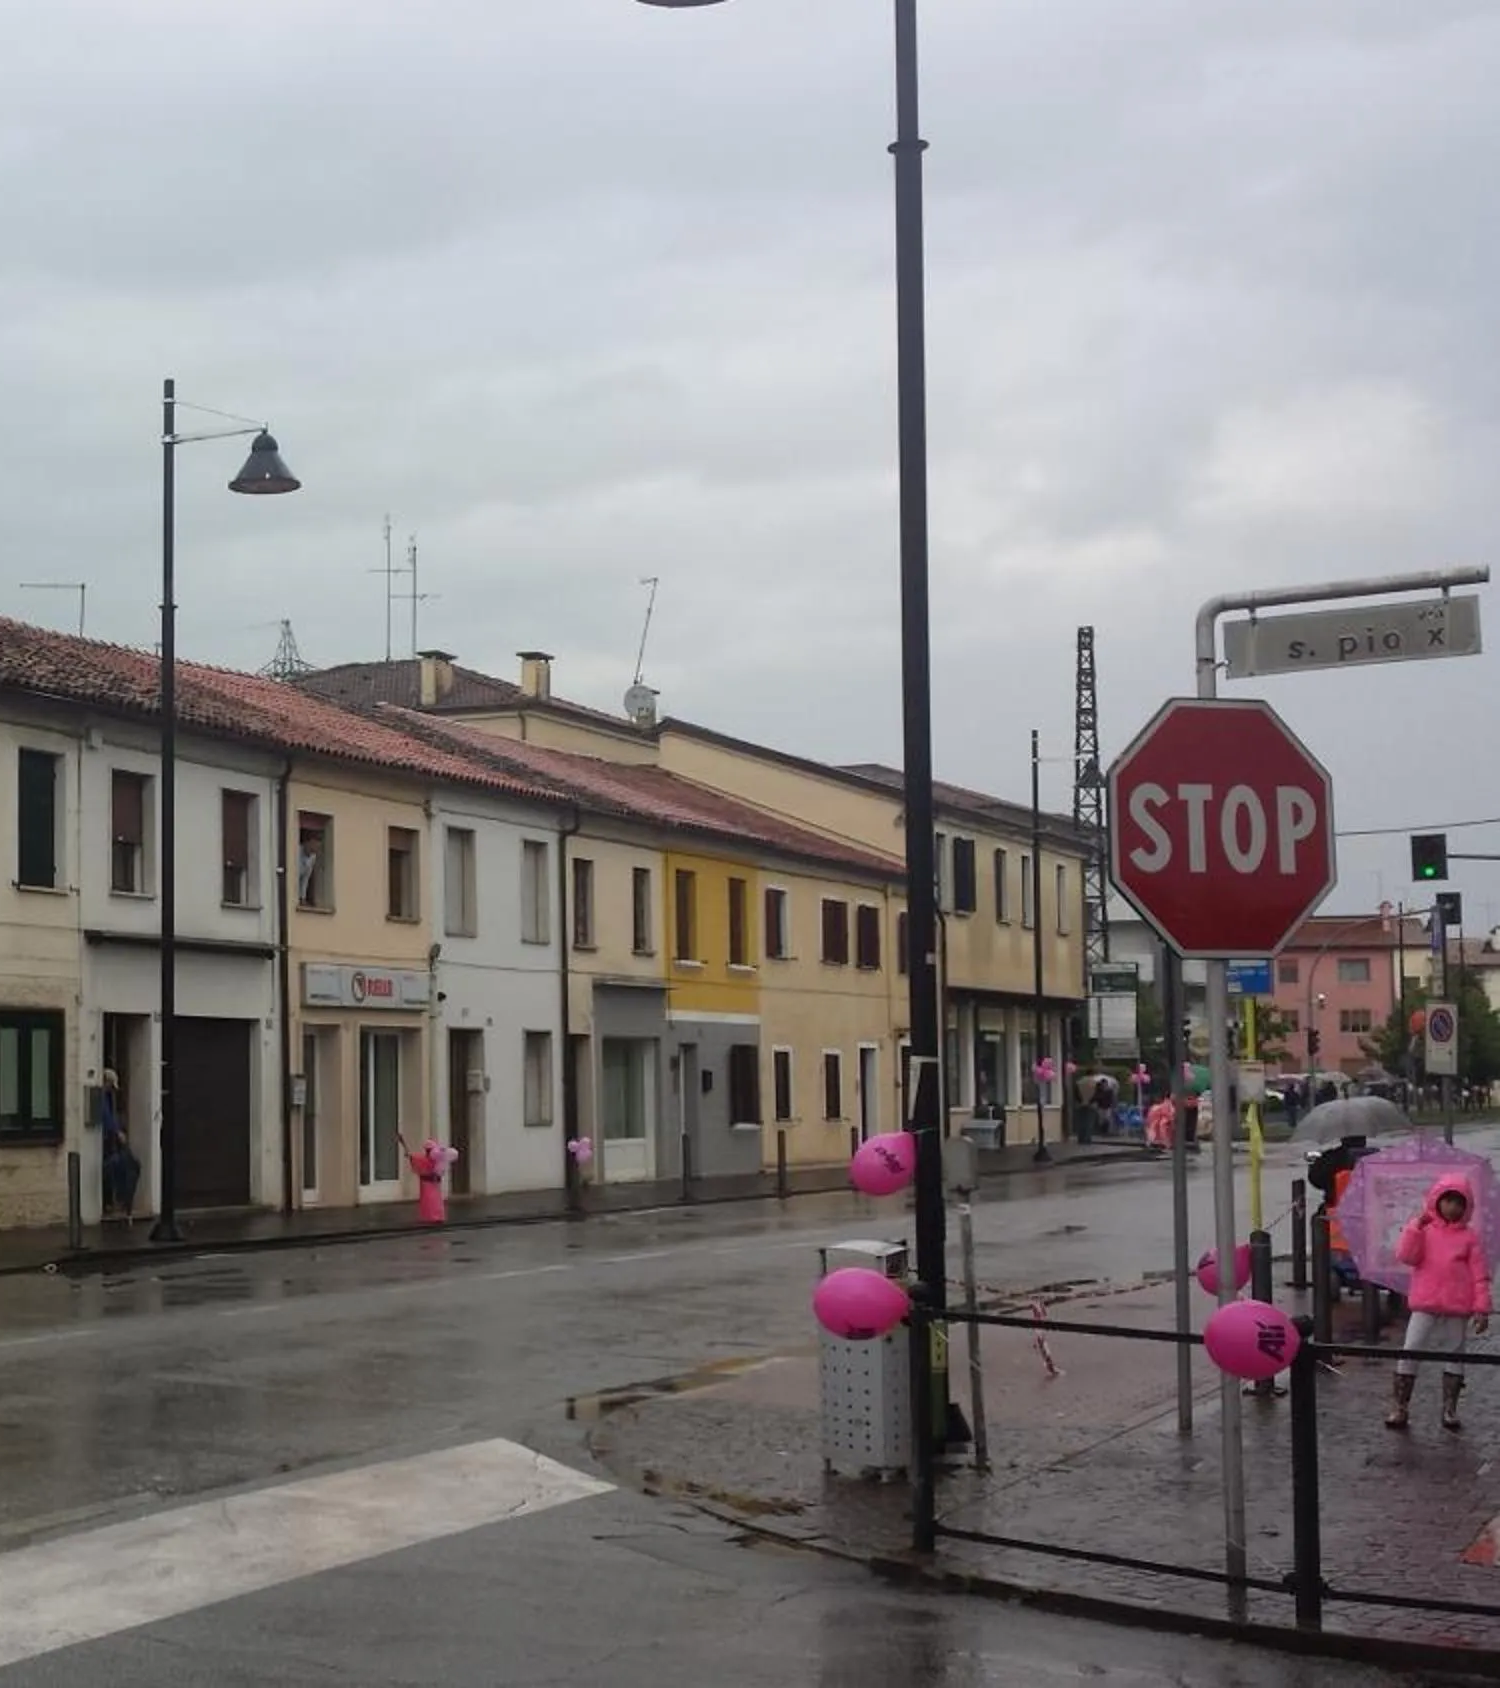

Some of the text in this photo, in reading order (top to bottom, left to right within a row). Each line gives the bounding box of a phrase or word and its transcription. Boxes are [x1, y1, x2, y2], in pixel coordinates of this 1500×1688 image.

[1288, 640, 1316, 659] s.
[1338, 627, 1402, 661] pio
[1129, 782, 1317, 874] STOP
